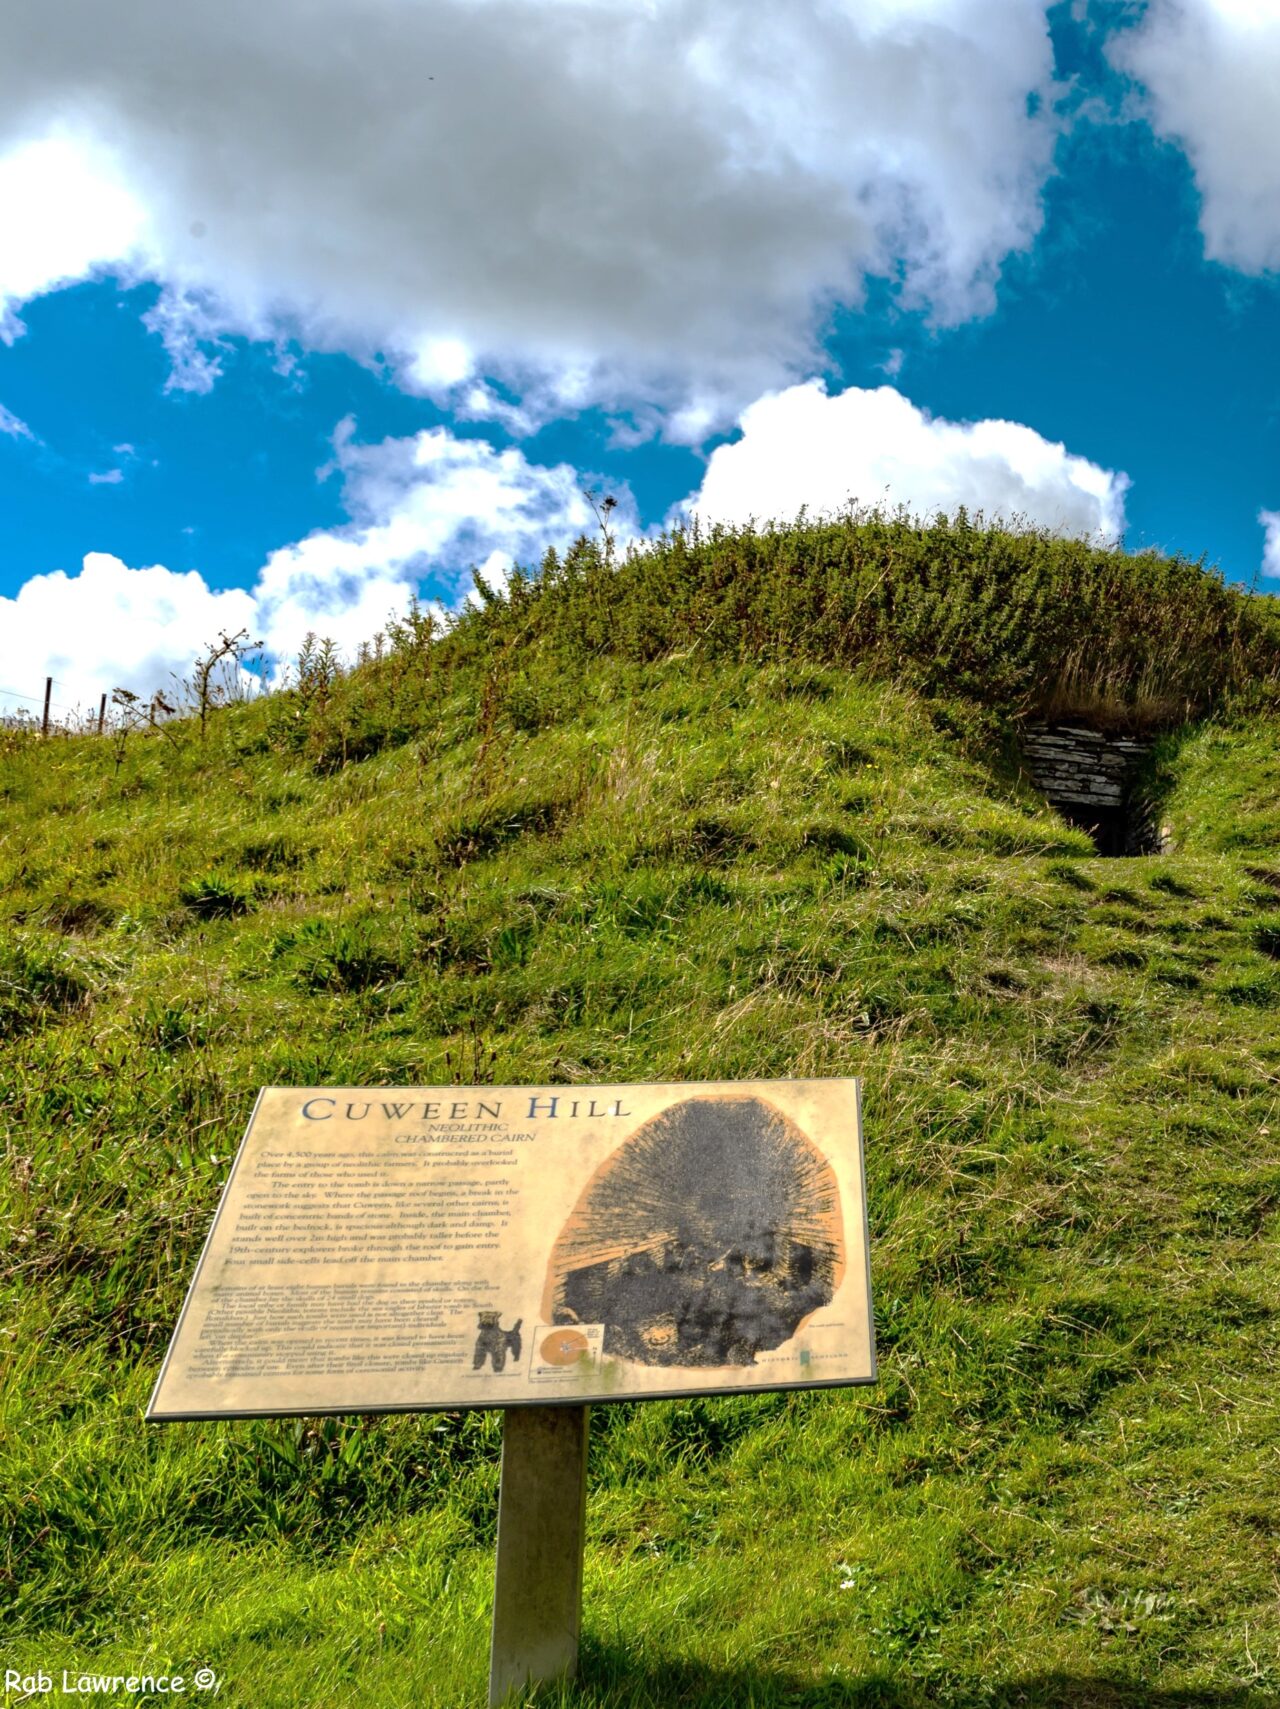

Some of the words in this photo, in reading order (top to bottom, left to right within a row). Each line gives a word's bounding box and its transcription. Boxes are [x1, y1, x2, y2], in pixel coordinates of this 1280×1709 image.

[302, 1097, 504, 1122] CUWEEN
[526, 1096, 633, 1119] HILL
[428, 1122, 510, 1133] NEOLITHIC
[395, 1133, 489, 1144] CHAMBERED
[489, 1132, 537, 1143] CAIRN
